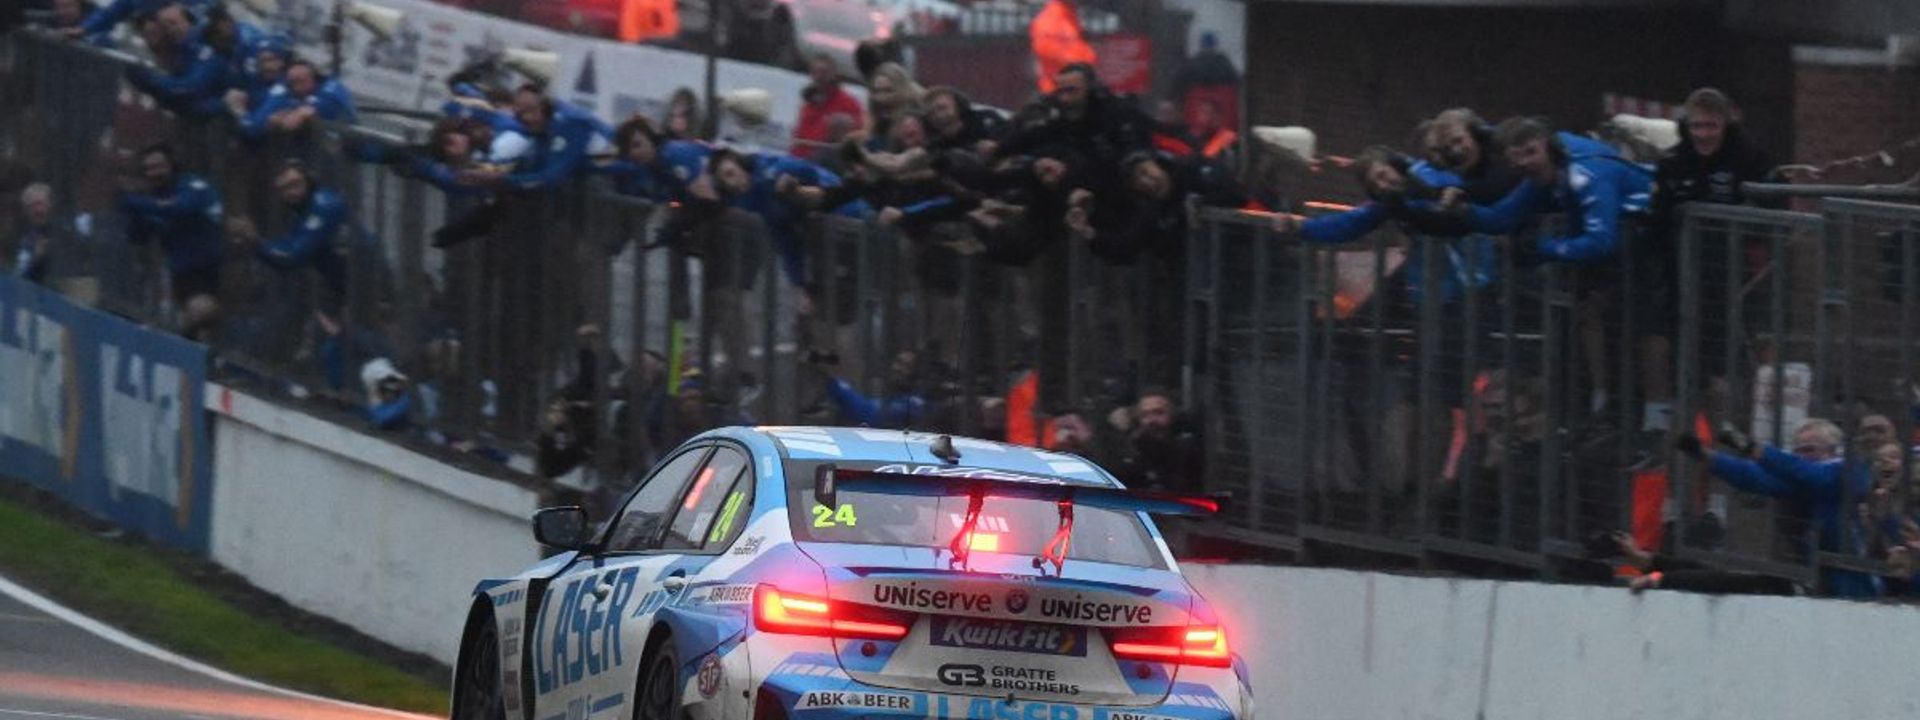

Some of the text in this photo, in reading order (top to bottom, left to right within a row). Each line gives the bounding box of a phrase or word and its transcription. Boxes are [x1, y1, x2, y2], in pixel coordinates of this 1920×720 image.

[710, 491, 745, 542] 24
[812, 503, 857, 528] 24
[536, 566, 640, 695] LASER
[991, 665, 1057, 682] GRATTE
[991, 678, 1080, 695] BROTHERS
[806, 692, 910, 709] ABK BEER
